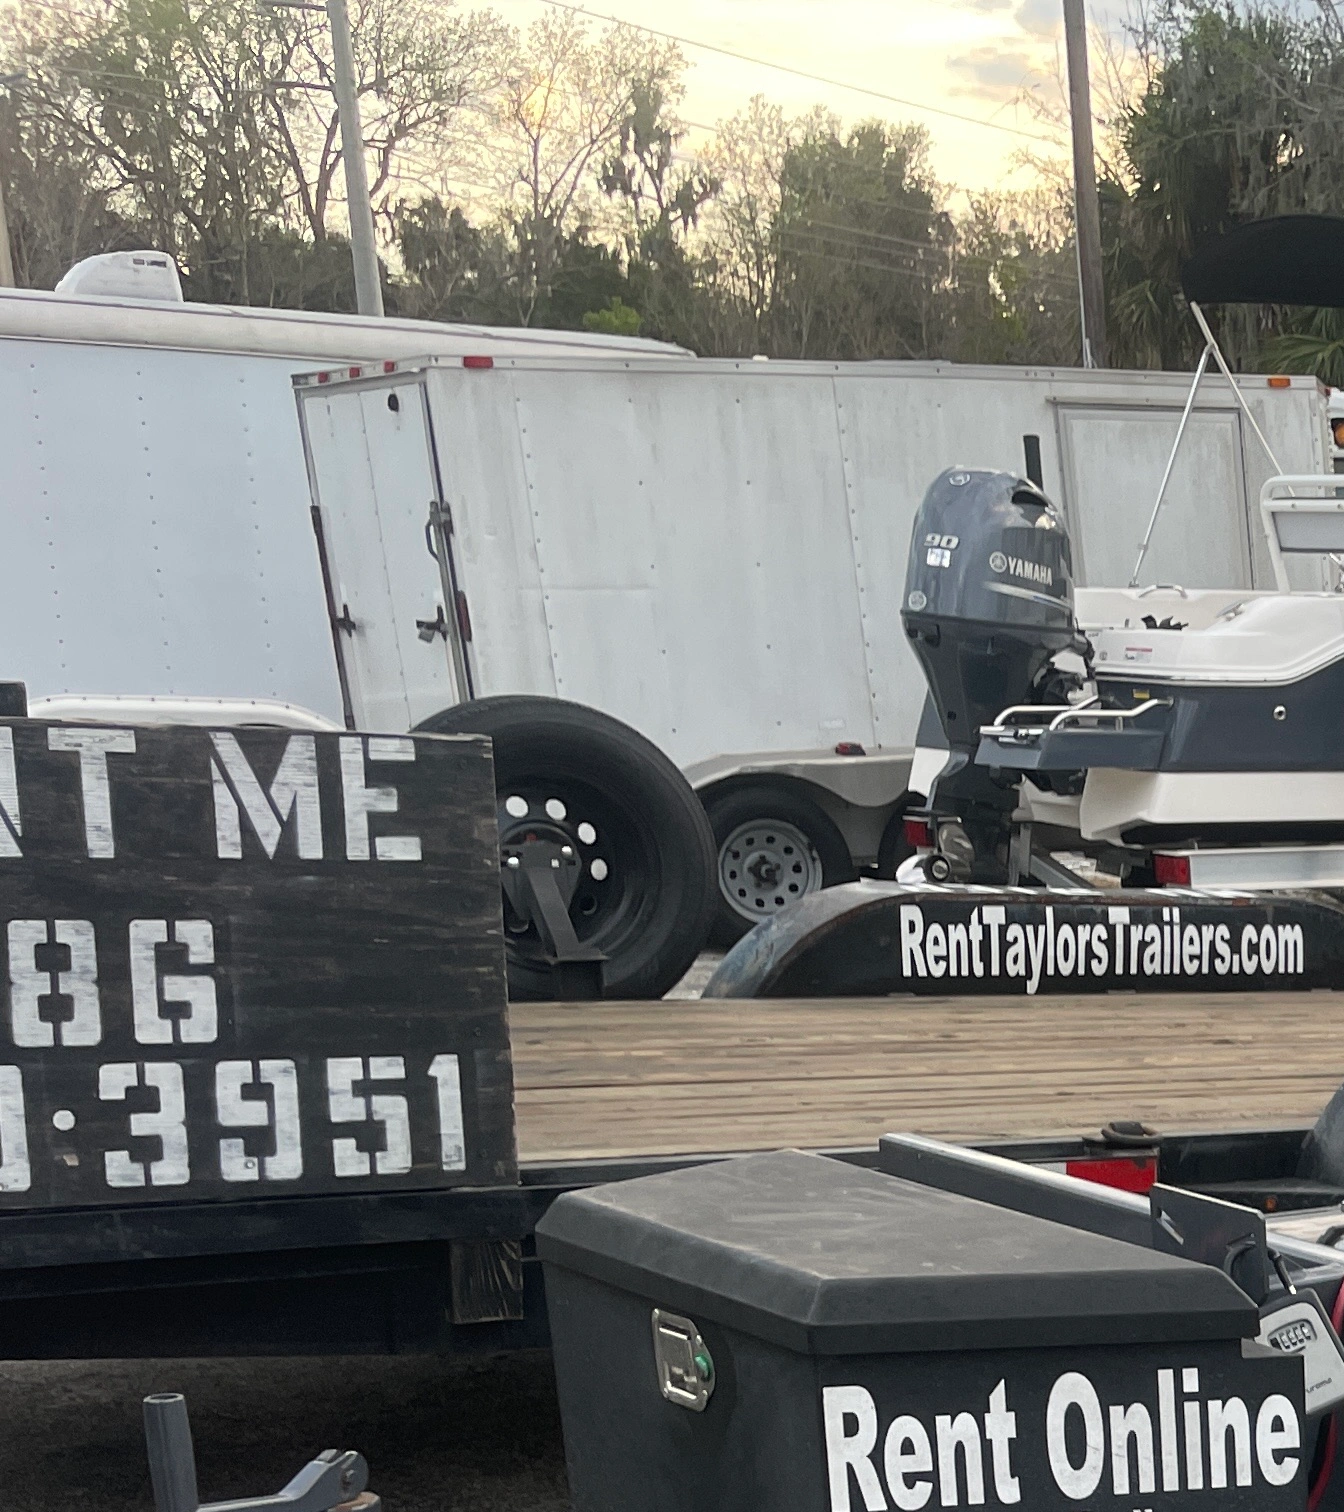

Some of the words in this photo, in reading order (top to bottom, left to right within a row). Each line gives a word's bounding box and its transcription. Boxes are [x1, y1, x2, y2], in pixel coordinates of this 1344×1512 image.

[924, 533, 960, 549] 90
[1008, 556, 1053, 586] YAMAHA
[208, 731, 422, 861] ME
[899, 903, 1304, 996] RentTaylorsTrailers.com
[1046, 1367, 1301, 1501] Online
